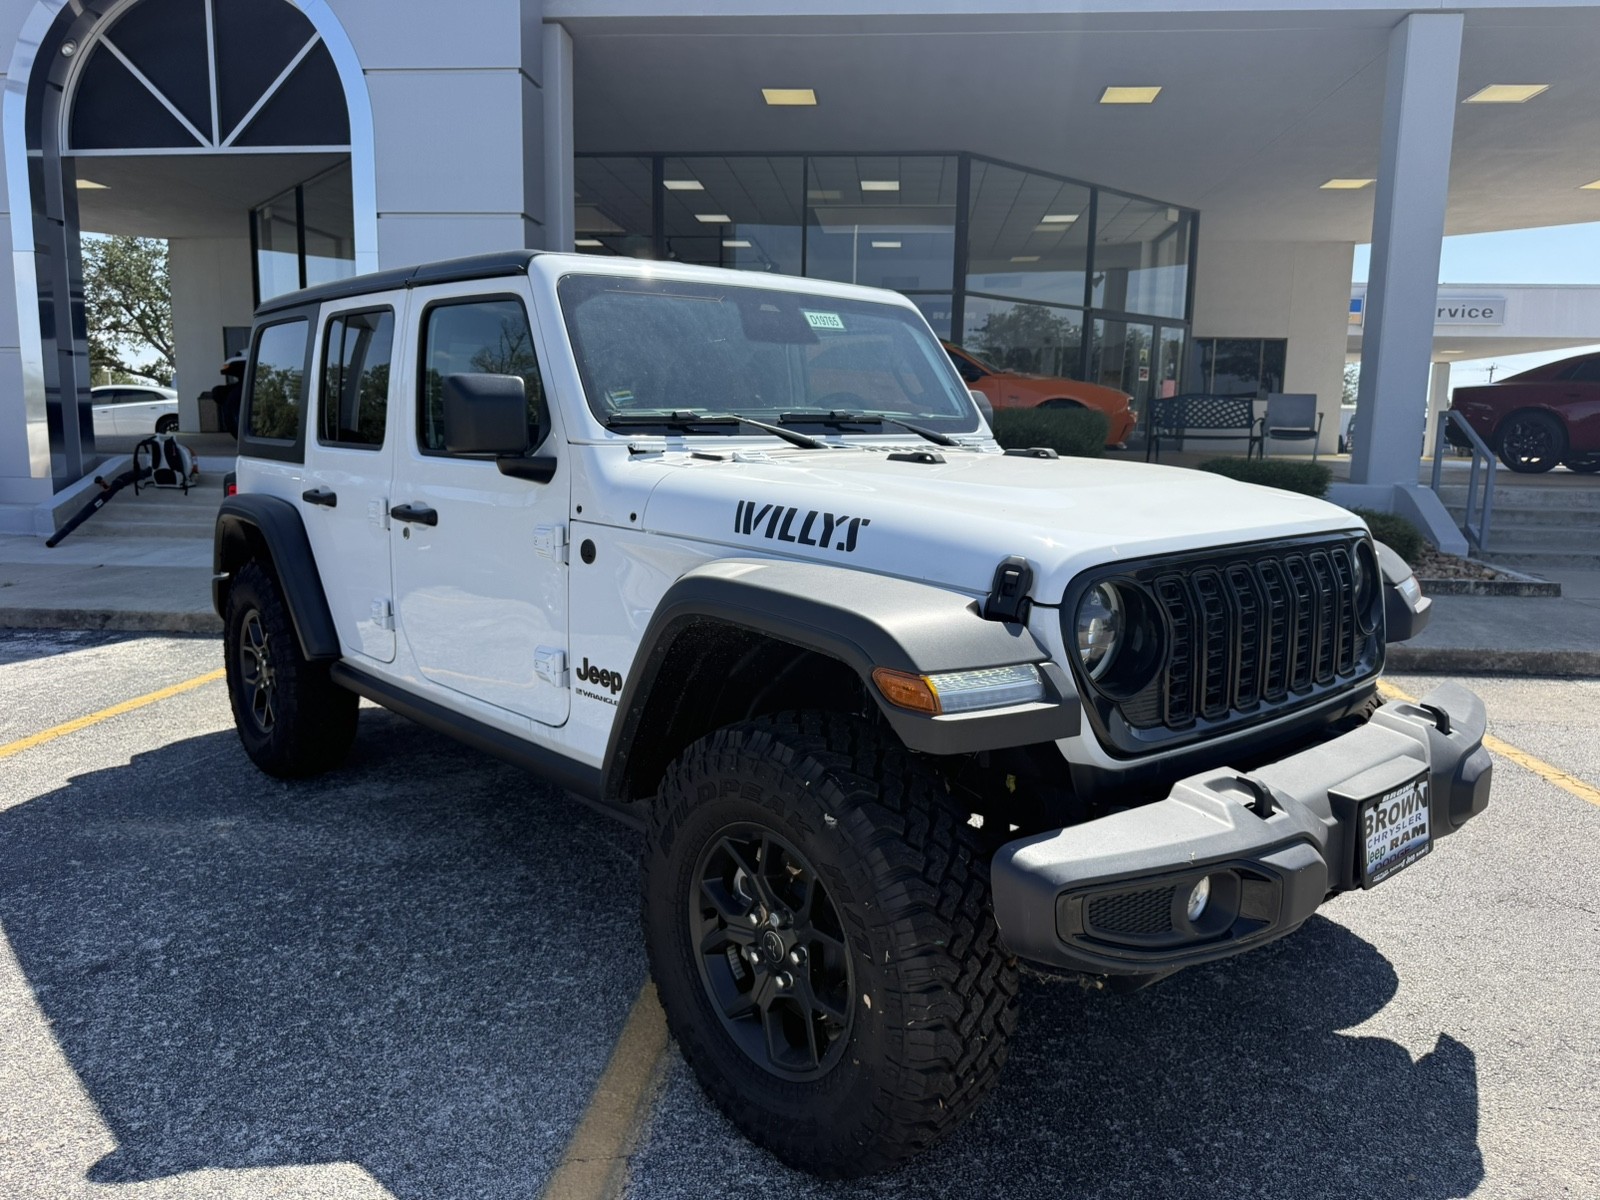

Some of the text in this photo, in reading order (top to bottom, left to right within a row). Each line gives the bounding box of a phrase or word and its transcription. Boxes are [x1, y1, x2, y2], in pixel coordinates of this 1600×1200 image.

[809, 314, 840, 327] D19765
[1437, 304, 1494, 319] rvice
[734, 499, 871, 552] WILLYS
[576, 657, 623, 695] Jeep
[582, 689, 619, 706] WRANGLE
[1365, 786, 1428, 839] BROWN
[1367, 812, 1422, 849] CHRYSLER
[1367, 844, 1386, 864] Jeep
[1390, 822, 1426, 851] RAM
